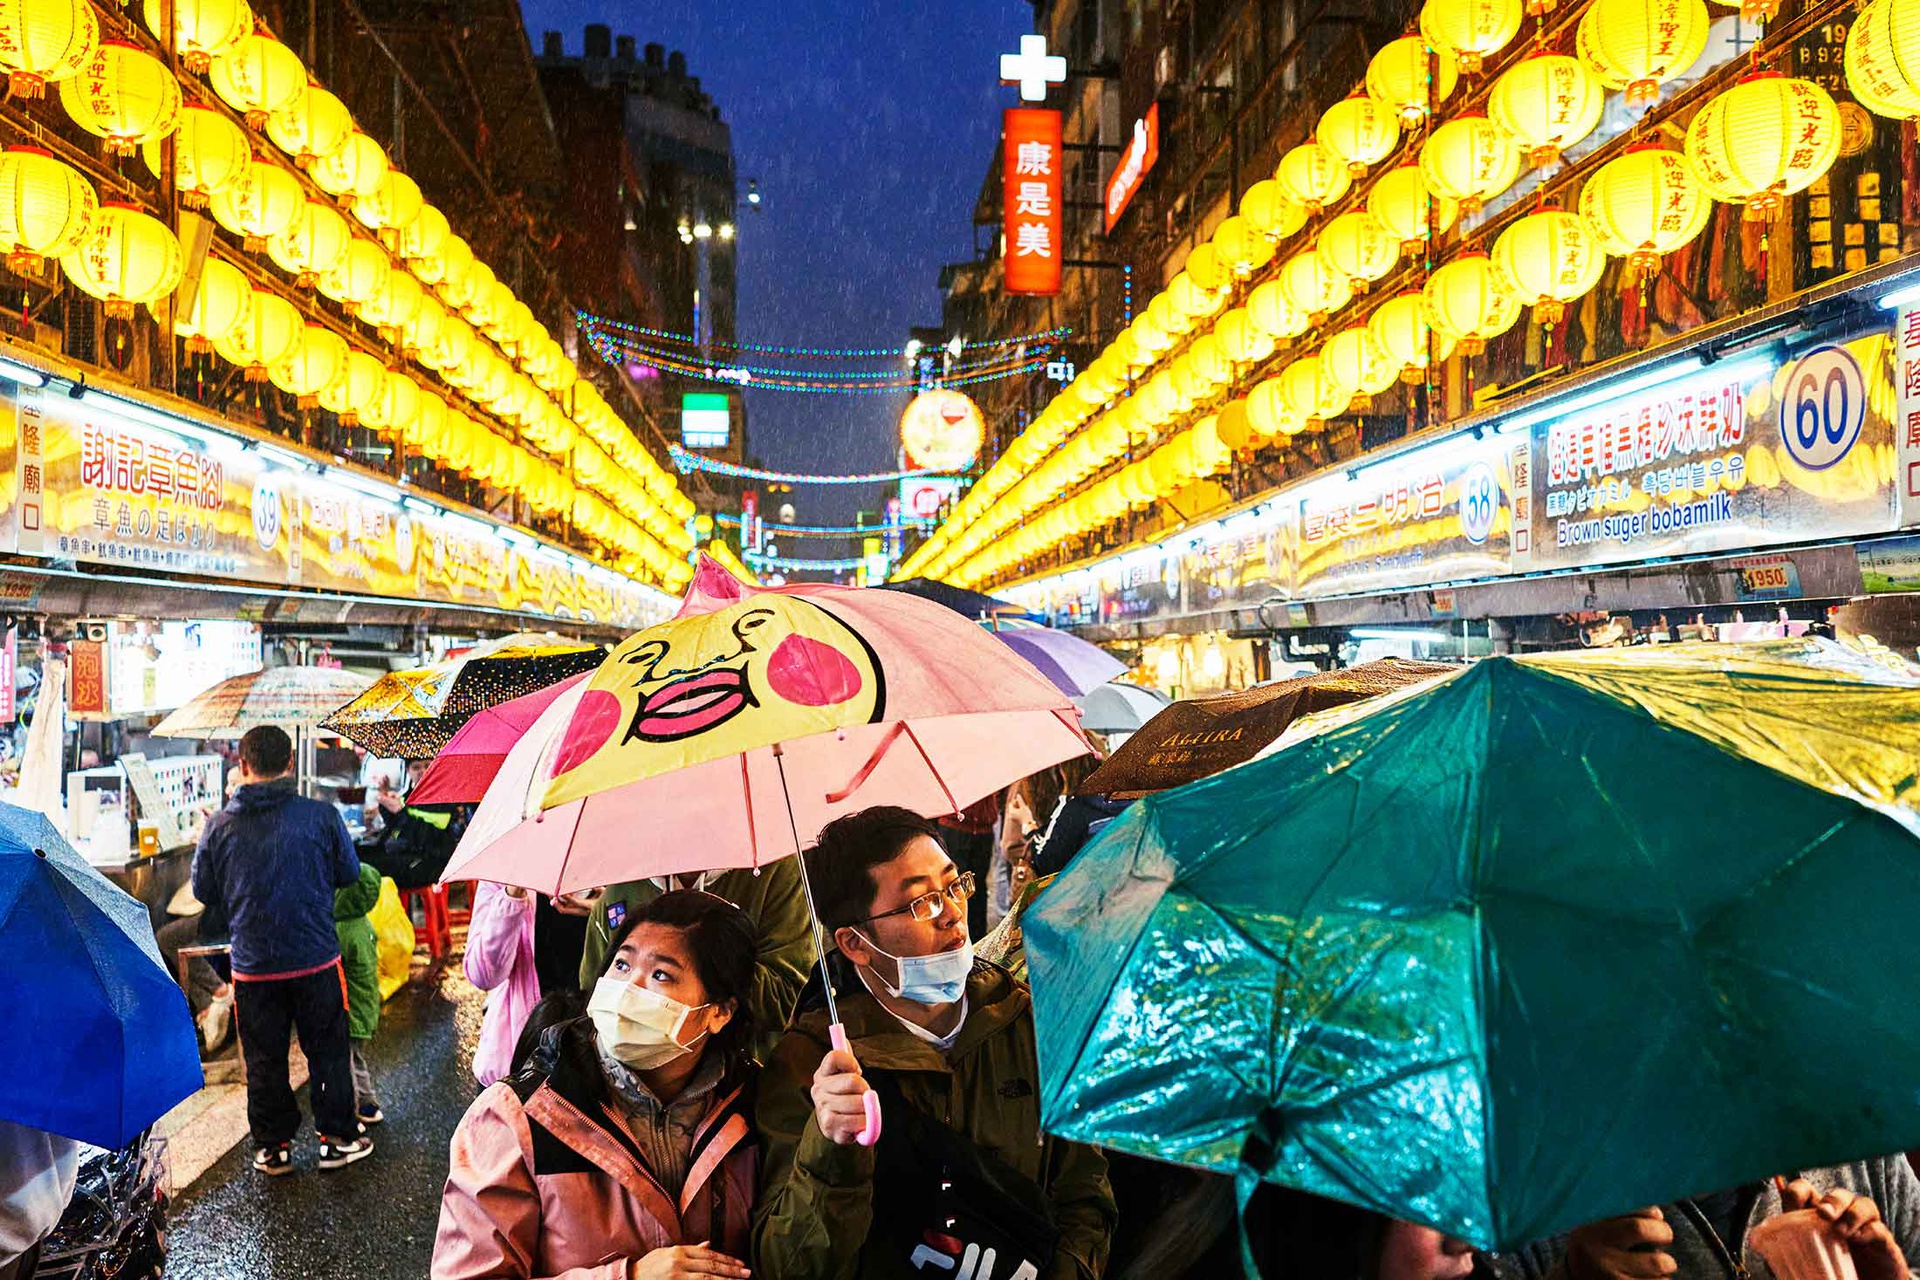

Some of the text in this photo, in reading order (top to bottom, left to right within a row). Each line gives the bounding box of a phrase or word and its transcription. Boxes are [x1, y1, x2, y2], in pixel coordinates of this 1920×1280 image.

[1788, 82, 1823, 171] 歡迎光臨
[1016, 141, 1052, 258] 康是美
[1658, 154, 1688, 233] 歡迎光臨
[1796, 366, 1848, 450] 60
[83, 423, 224, 513] 謝記章魚腳
[1466, 475, 1492, 529] 58
[93, 497, 215, 549] 章魚の足ばかり
[259, 487, 276, 534] 39
[1559, 492, 1733, 544] Brown suger bobamilk
